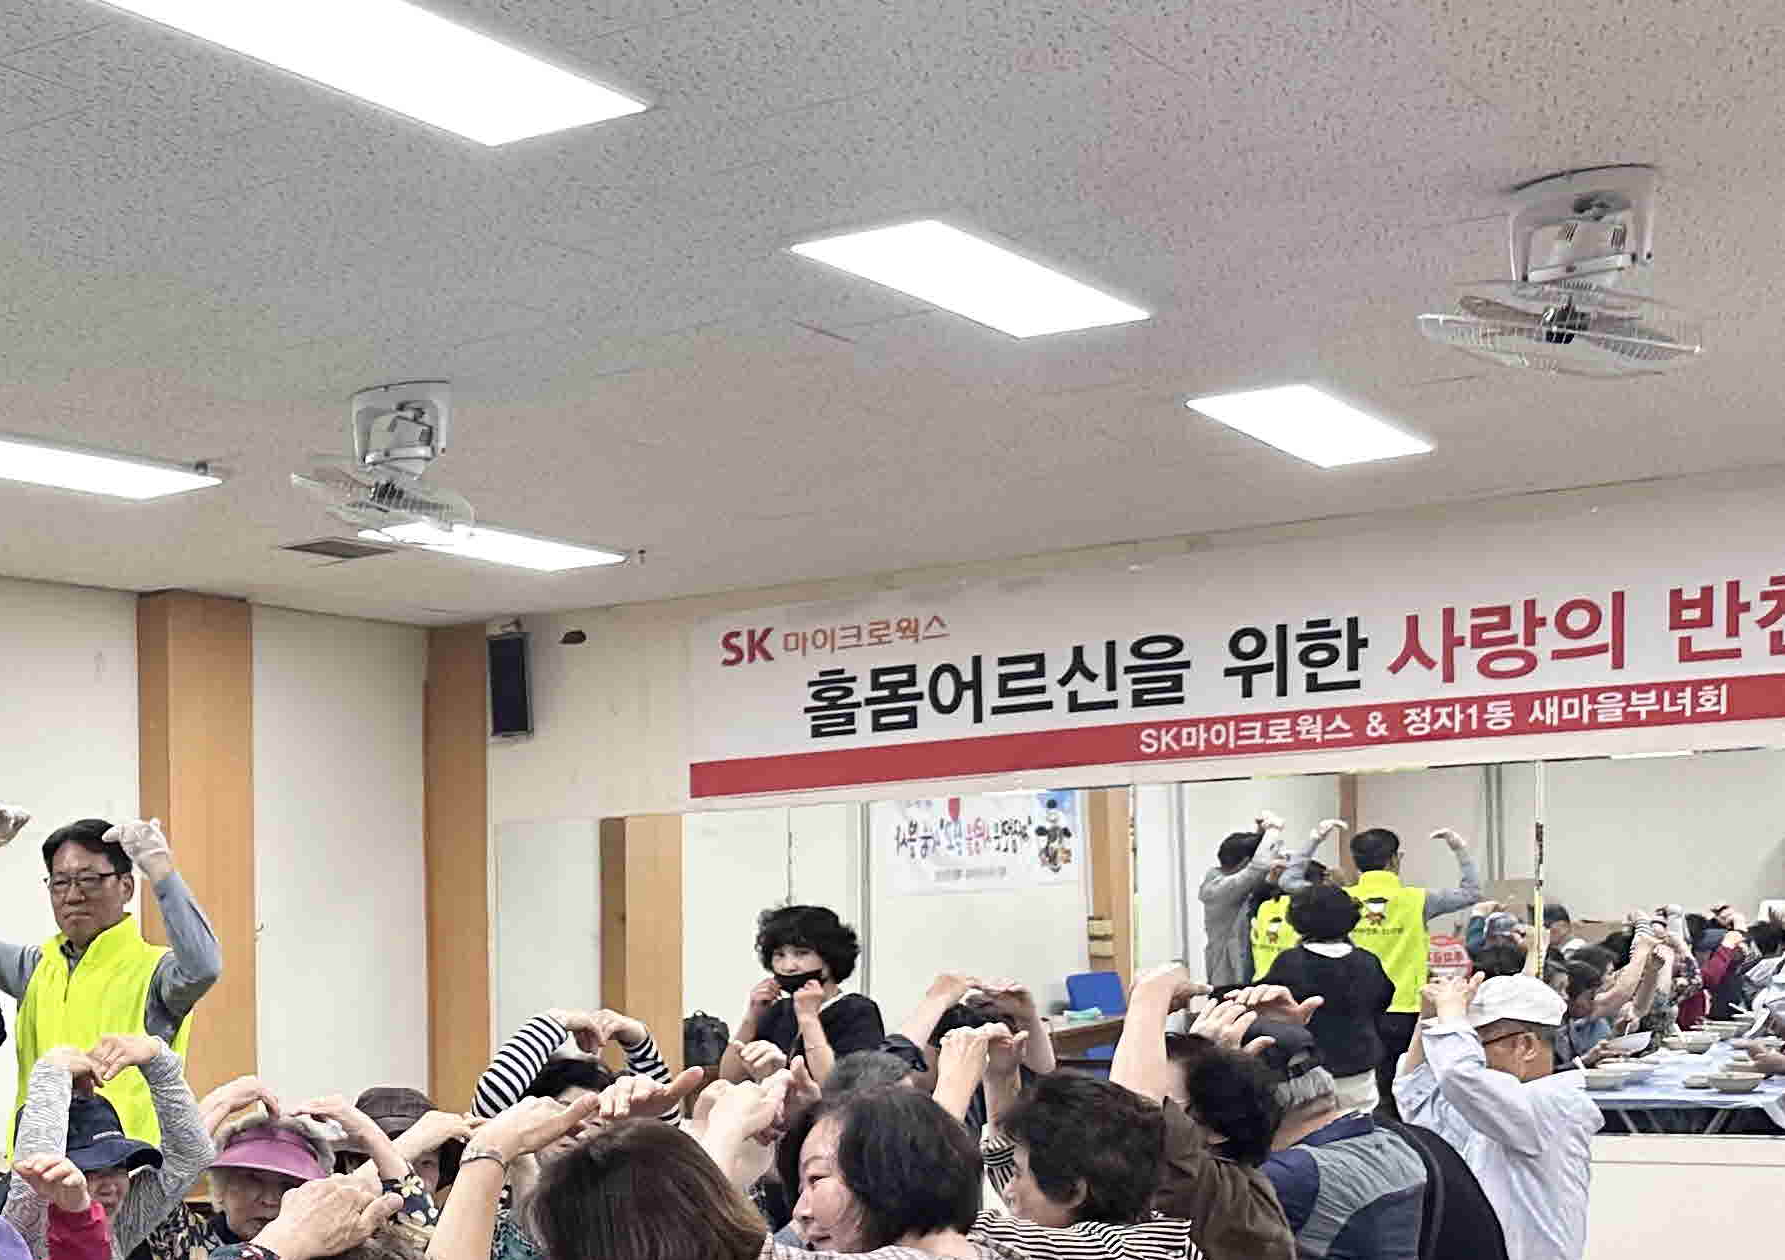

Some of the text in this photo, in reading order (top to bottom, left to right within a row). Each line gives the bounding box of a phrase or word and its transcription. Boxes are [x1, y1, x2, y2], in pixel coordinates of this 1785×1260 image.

[720, 614, 951, 667] SK 마이크로웍스
[803, 629, 1193, 739] 홀몸어르신을
[1223, 616, 1370, 698] 위한
[1387, 589, 1627, 684] 사랑의
[1139, 684, 1729, 753] SK마이크로웍스 & 정자1동 새마을부녀회
